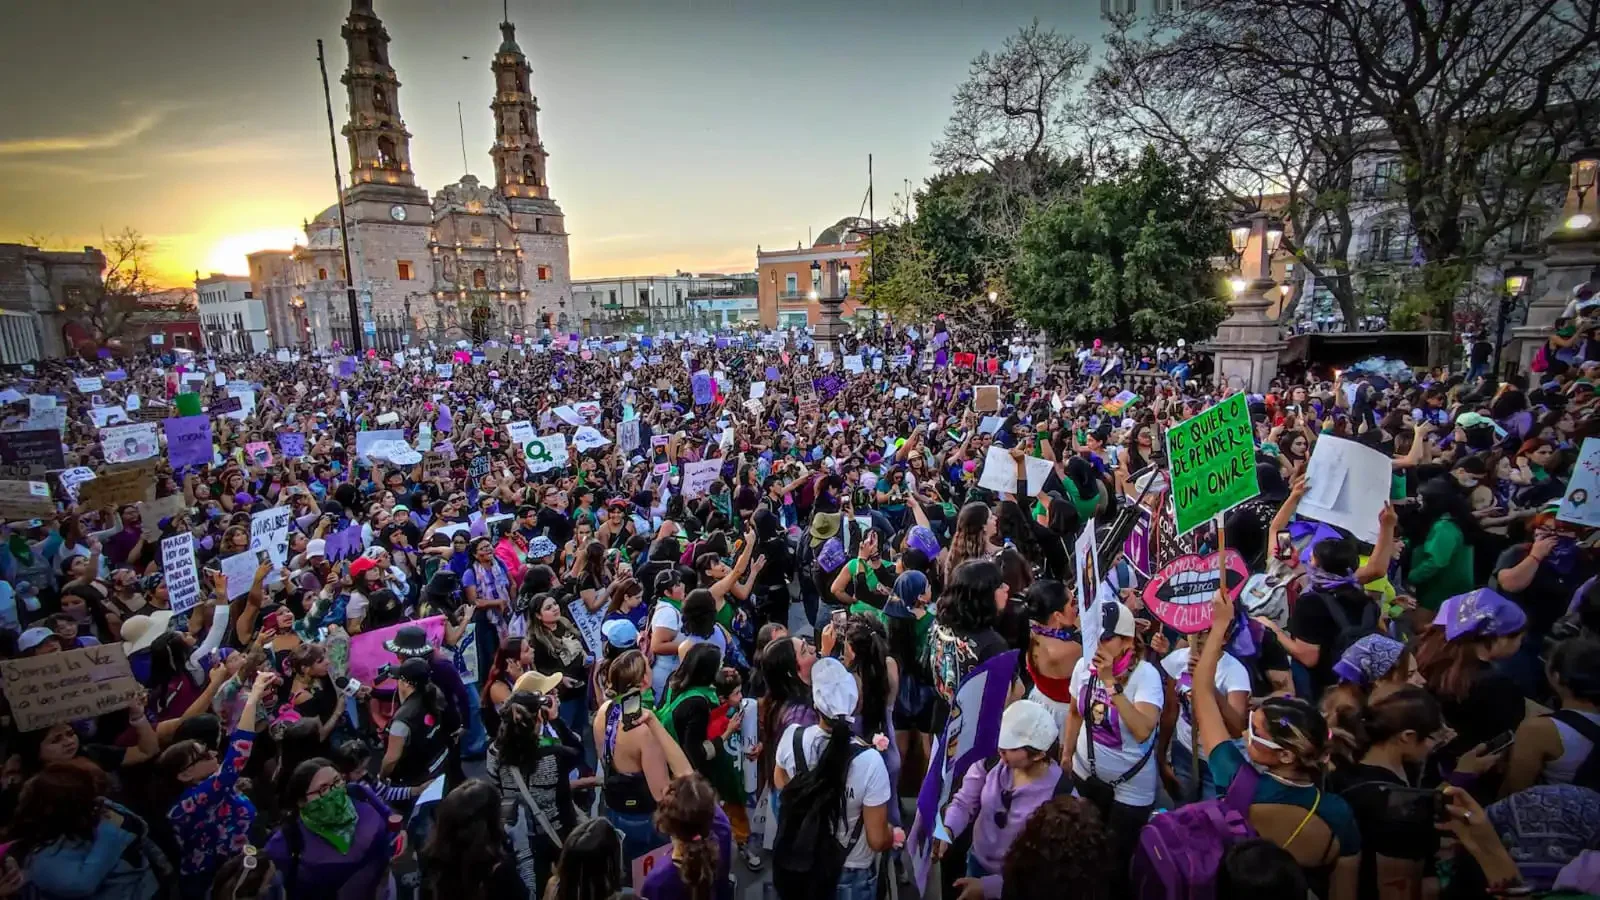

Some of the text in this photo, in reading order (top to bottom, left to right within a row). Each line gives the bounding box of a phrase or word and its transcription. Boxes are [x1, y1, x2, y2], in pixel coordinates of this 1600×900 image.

[1173, 424, 1250, 477] DEPENDER DE
[1178, 480, 1199, 509] UN
[1208, 450, 1253, 494] ONVRE
[1154, 556, 1196, 589] SOMOS
[1155, 603, 1169, 616] SE
